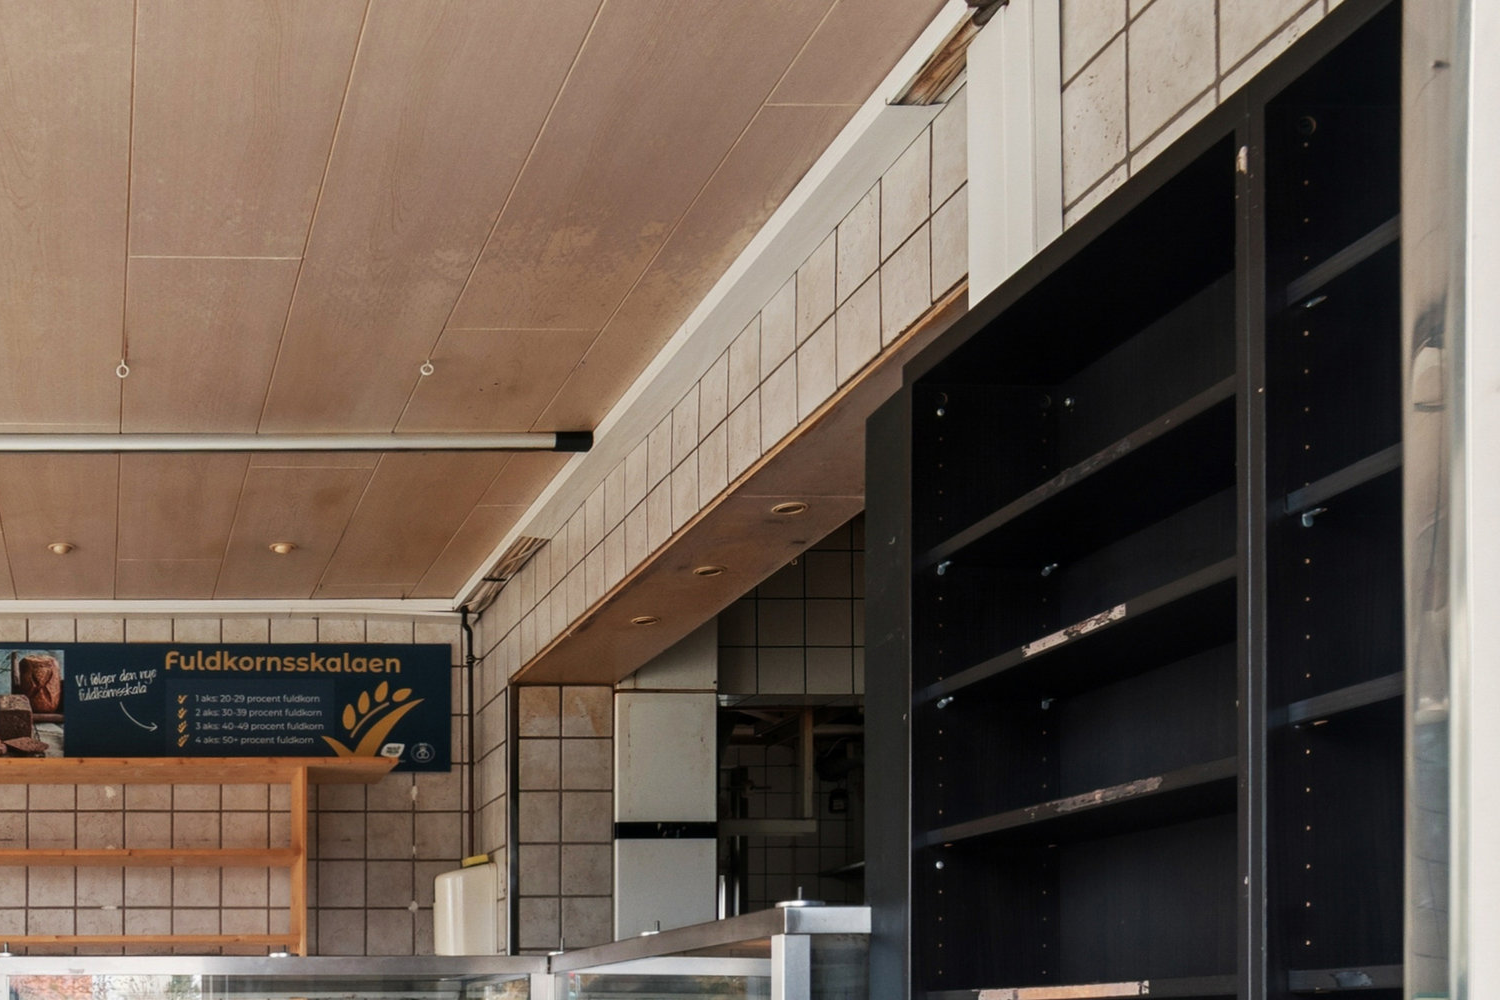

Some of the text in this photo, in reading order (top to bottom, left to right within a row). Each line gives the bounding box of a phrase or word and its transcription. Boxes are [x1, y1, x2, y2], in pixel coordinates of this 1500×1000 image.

[165, 650, 401, 673] Fuldkornsskalaen
[75, 674, 87, 687] Vi
[119, 668, 138, 682] den
[139, 669, 157, 685] nye
[220, 694, 245, 703] 20-29
[246, 695, 281, 704] procent
[282, 694, 320, 703] fuldkorn
[221, 708, 248, 717] 30-39
[248, 709, 283, 718] procent
[284, 708, 322, 717] fuldkorn
[221, 722, 250, 730] 40-49
[250, 723, 285, 731] procent
[286, 722, 324, 730] fuldkorn
[240, 737, 275, 745] procent
[276, 736, 314, 744] fuldkorn
